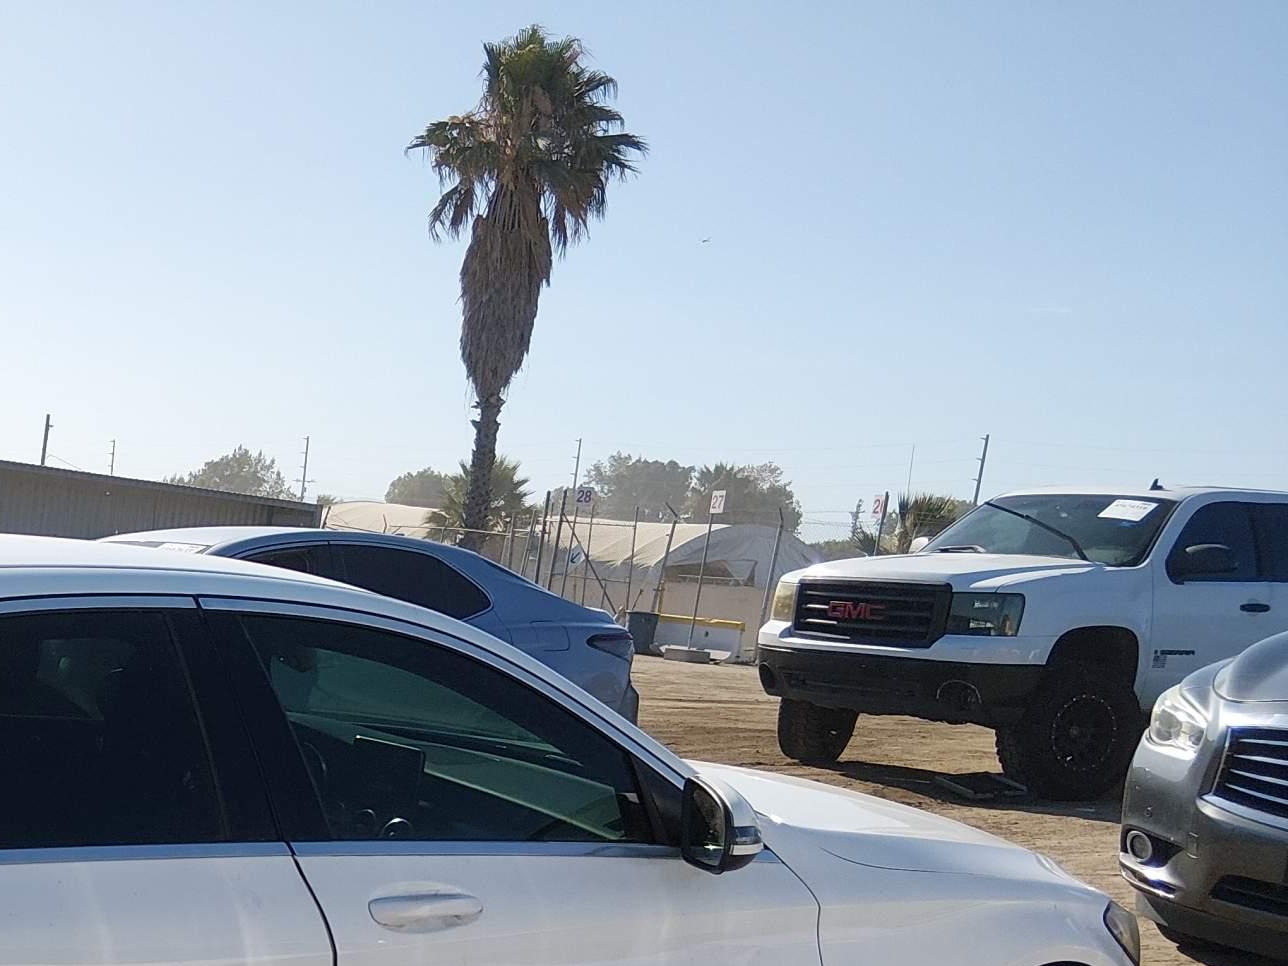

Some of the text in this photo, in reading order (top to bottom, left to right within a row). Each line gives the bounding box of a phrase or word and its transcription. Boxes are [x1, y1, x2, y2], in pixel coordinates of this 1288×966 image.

[576, 489, 593, 503] 28
[711, 495, 724, 509] 27
[828, 601, 886, 619] GMC
